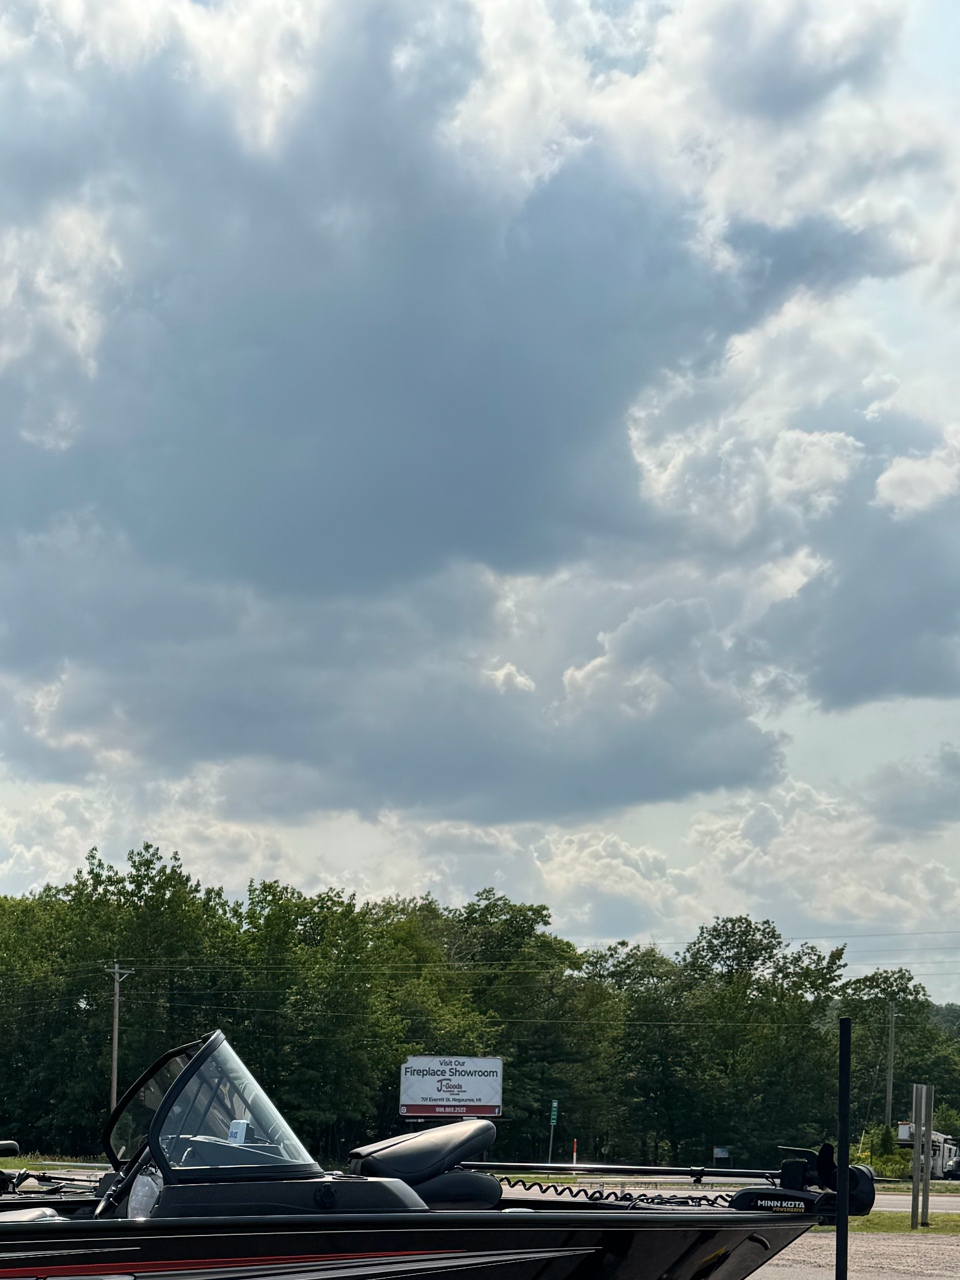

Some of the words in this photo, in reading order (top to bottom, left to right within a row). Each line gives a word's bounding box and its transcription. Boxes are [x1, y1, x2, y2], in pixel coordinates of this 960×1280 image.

[439, 1059, 453, 1067] Visit
[404, 1067, 447, 1078] Fireplace
[448, 1067, 498, 1077] Showroom
